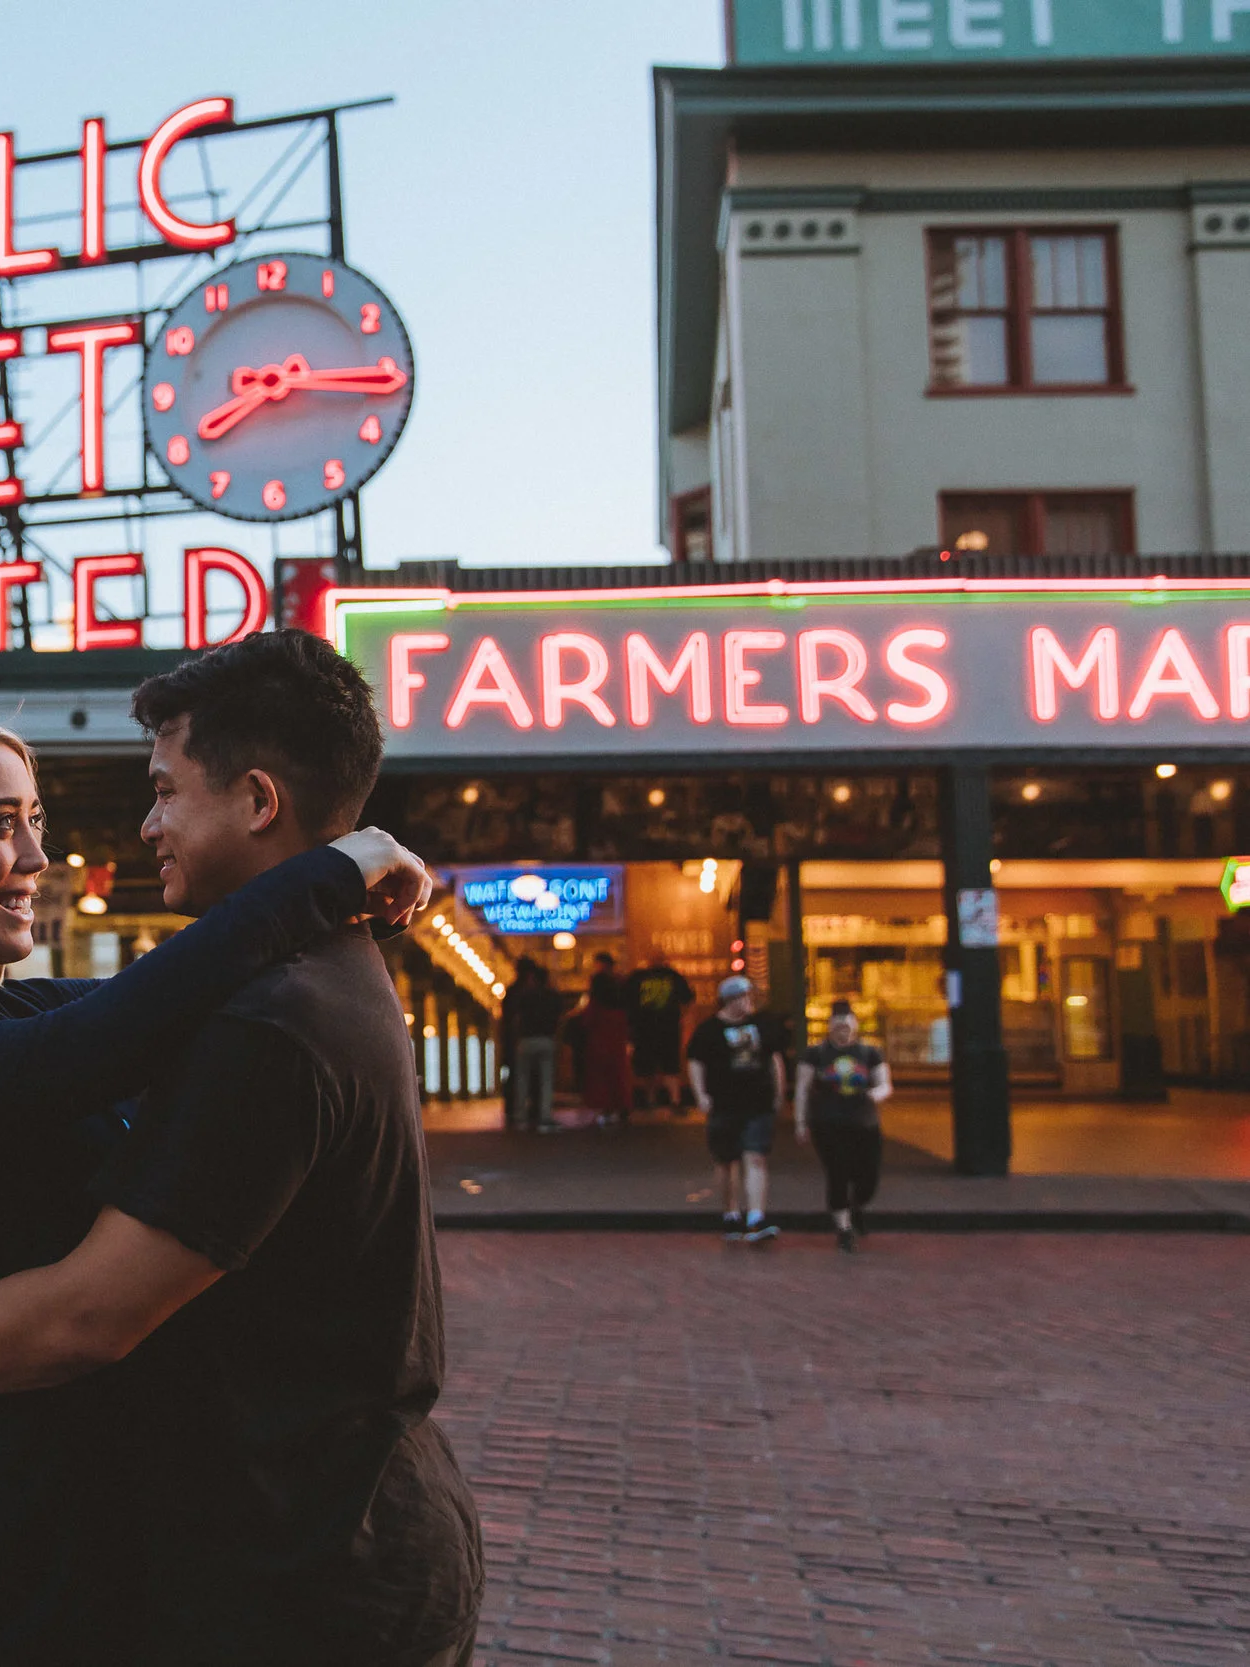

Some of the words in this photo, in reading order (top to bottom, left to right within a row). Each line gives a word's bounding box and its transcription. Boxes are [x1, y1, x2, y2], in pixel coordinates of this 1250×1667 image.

[257, 260, 287, 291] 12
[322, 270, 334, 297] 1
[205, 283, 229, 312] 11
[360, 303, 381, 334] 2
[166, 326, 194, 356] 10
[152, 382, 175, 412] 9
[359, 415, 382, 444] 4
[209, 470, 231, 499] 7
[323, 459, 346, 490] 5
[262, 479, 287, 511] 6
[388, 627, 950, 729] FARMERS
